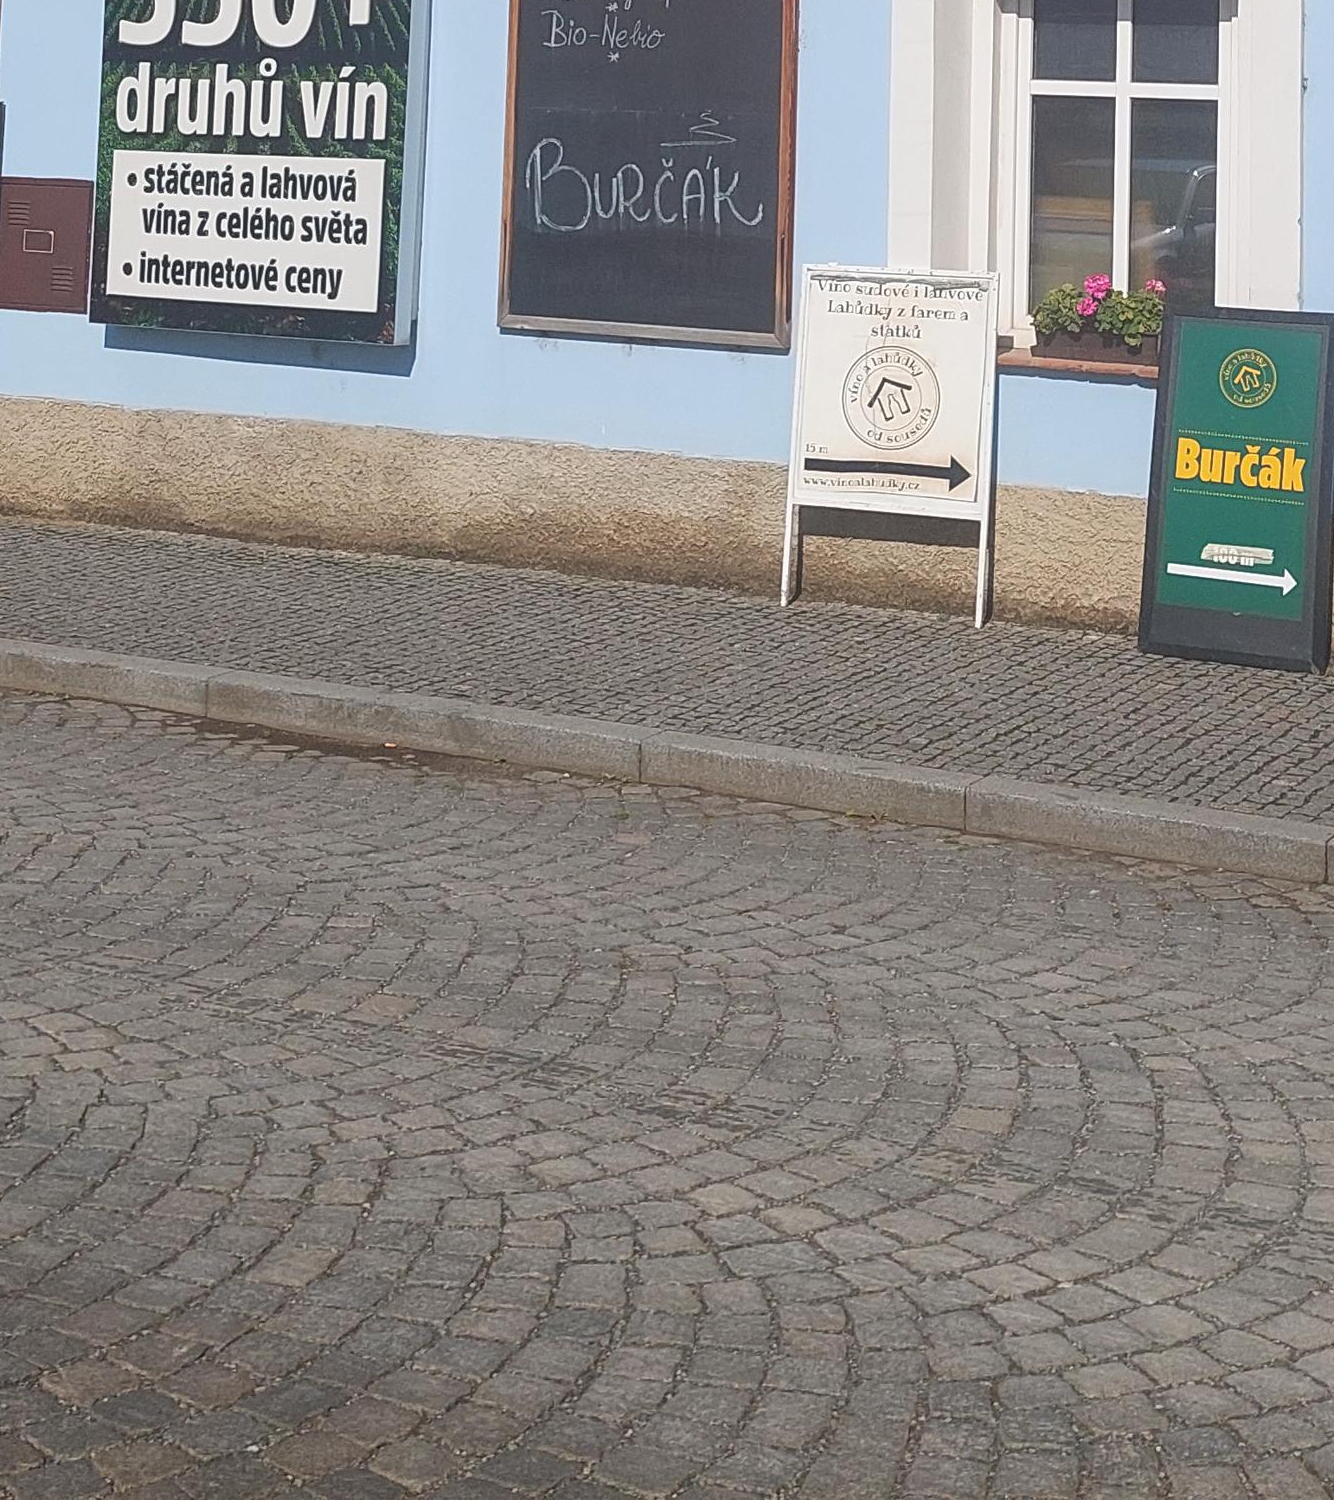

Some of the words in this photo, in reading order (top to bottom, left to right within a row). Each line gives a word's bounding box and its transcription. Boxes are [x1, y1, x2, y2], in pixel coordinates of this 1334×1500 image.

[115, 57, 284, 138] druhů
[300, 66, 389, 141] vín
[143, 162, 233, 198] stáčená
[239, 172, 254, 198] a
[261, 166, 357, 203] lahvová
[142, 204, 192, 237] vína
[197, 212, 209, 237] z
[215, 207, 295, 243] celého
[300, 210, 368, 245] světa
[139, 252, 278, 292] internetové
[285, 263, 343, 300] ceny
[855, 283, 910, 298] sudové
[914, 285, 919, 298] i
[827, 299, 893, 321] Lahůdky
[897, 307, 906, 317] z
[911, 305, 956, 321] farem
[960, 311, 969, 321] a
[848, 374, 864, 403] víno
[871, 352, 924, 378] lahůdky
[805, 443, 816, 453] 15
[867, 429, 883, 442] od
[1175, 436, 1307, 493] Burčák
